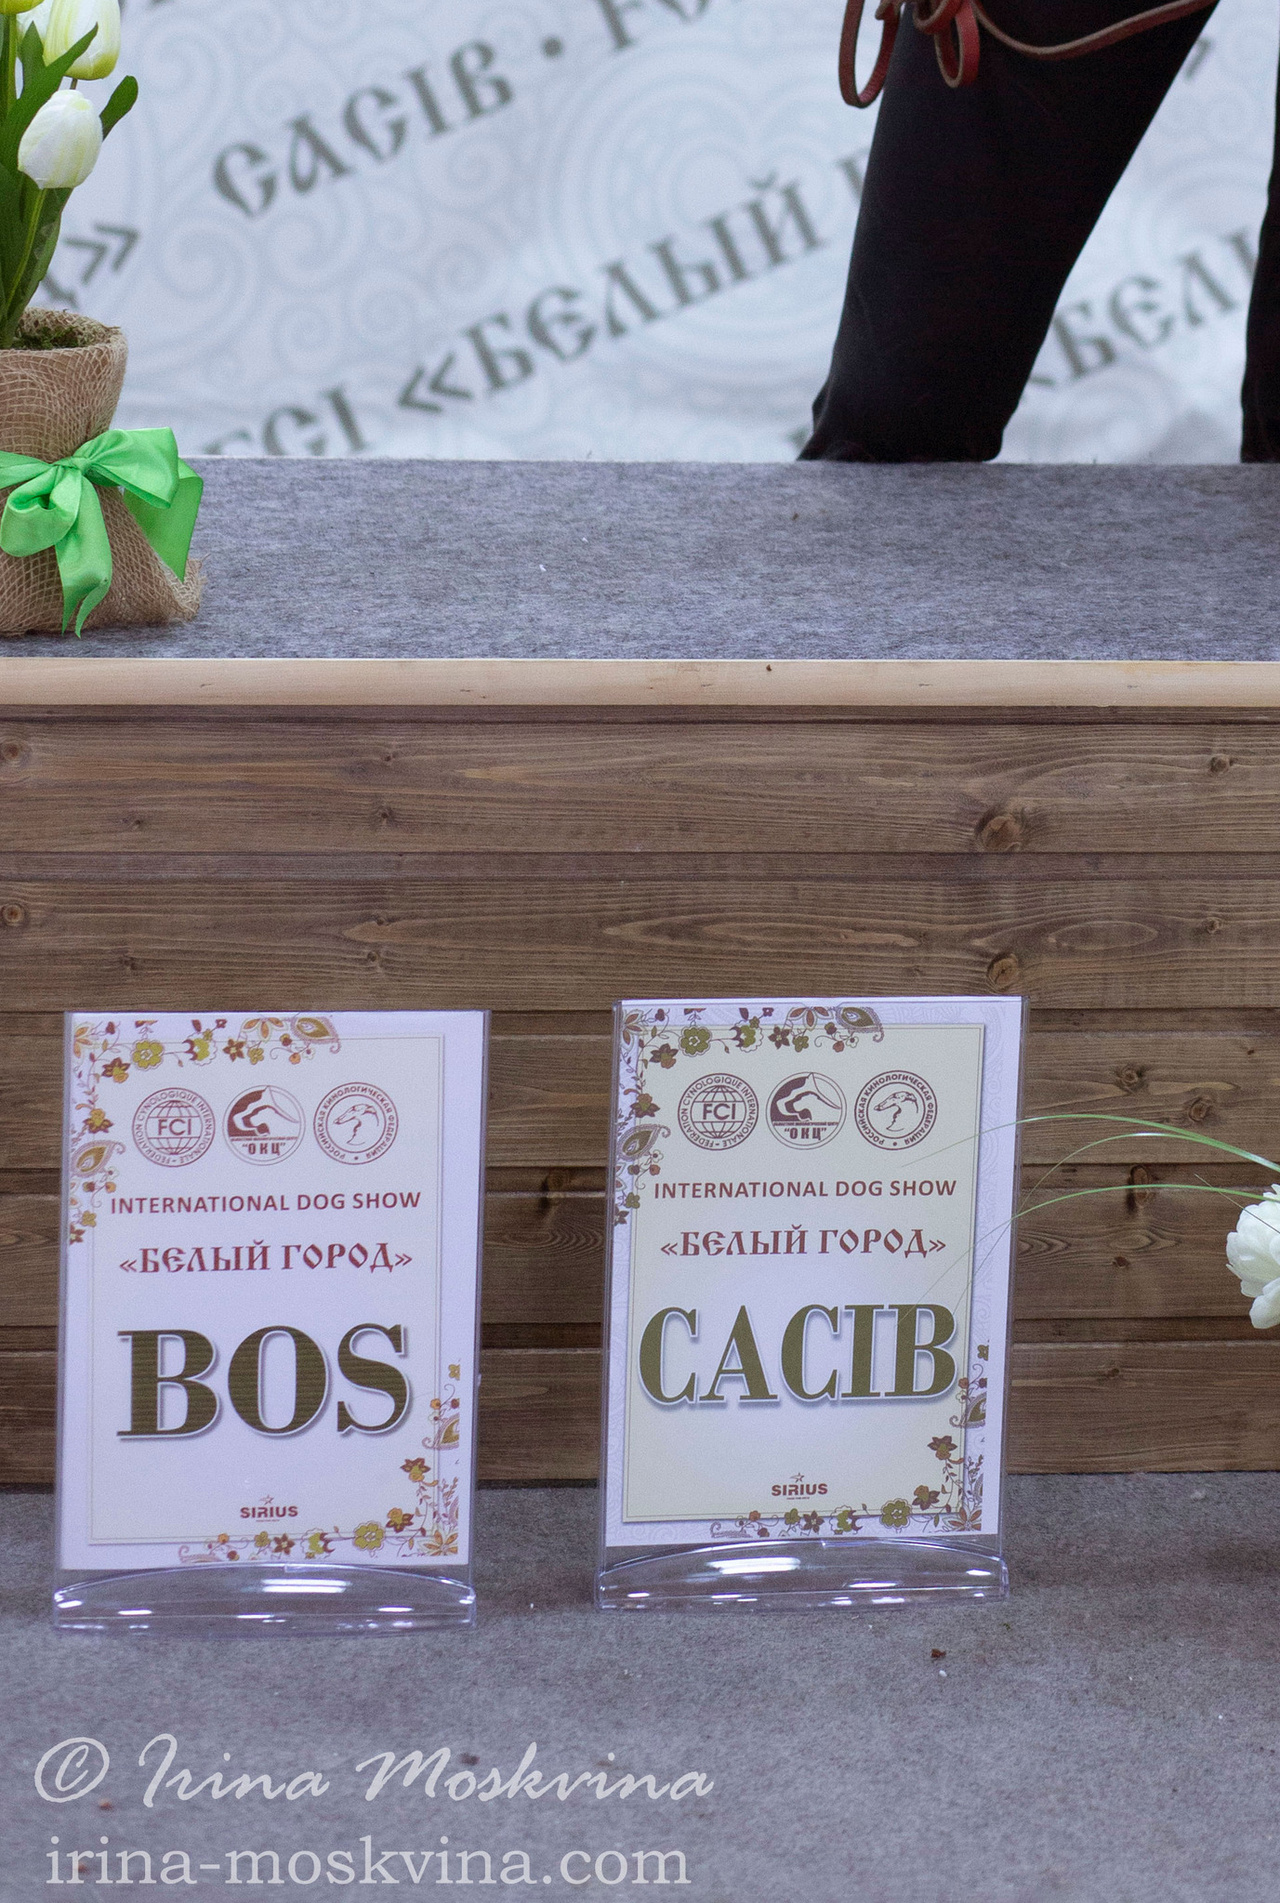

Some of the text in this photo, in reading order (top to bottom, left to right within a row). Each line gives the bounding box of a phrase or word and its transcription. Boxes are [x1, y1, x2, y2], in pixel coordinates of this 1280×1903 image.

[321, 1084, 393, 1114] КИНОЛОГИЧЕСКАЯ
[365, 1114, 395, 1160] ФЕДЕРАЦИЯ
[680, 1074, 756, 1150] FEDERATION CYNOLOGIQUE INTERNATIONALE
[702, 1103, 736, 1120] FCI
[857, 1071, 934, 1148] РОССИЙСКАЯ КИНОЛОГИЧЕСКАЯ ФЕДЕРАЦИЯ
[157, 1118, 192, 1136] FCI
[111, 1191, 421, 1214] INTERNATIONAL DOG SHOW
[654, 1179, 957, 1199] INTERNATIONAL DOG SHOW
[281, 1242, 412, 1273] ГОРОД»
[819, 1228, 946, 1258] ГОРОД»
[638, 1303, 960, 1406] CACIB
[116, 1322, 410, 1440] BOS
[771, 1483, 828, 1497] SIRIUS
[240, 1505, 298, 1518] SIRIUS
